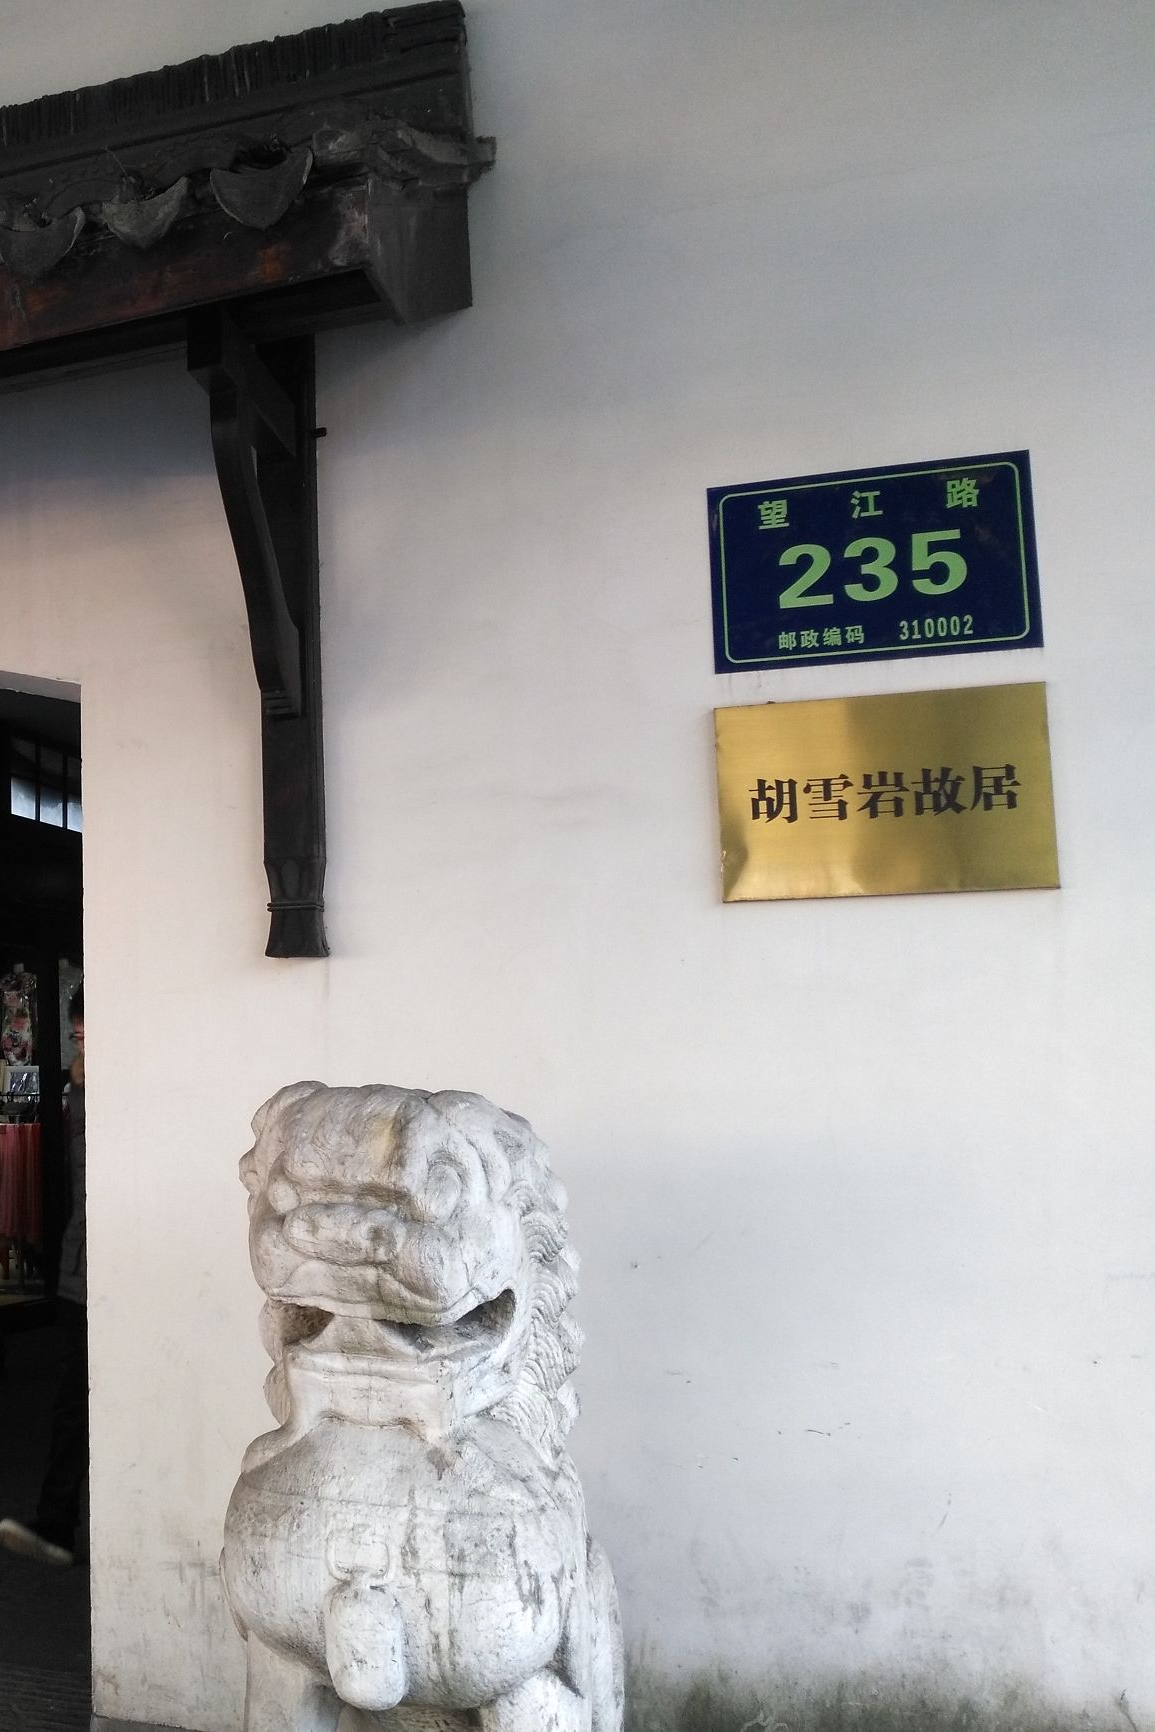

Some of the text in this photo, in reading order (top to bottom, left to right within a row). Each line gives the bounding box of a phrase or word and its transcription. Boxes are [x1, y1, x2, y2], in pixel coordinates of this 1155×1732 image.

[757, 477, 980, 530] 望江路
[778, 528, 968, 609] 235
[778, 614, 974, 650] 邮政编码 310002
[748, 763, 1022, 824] 胡雪岩故居
